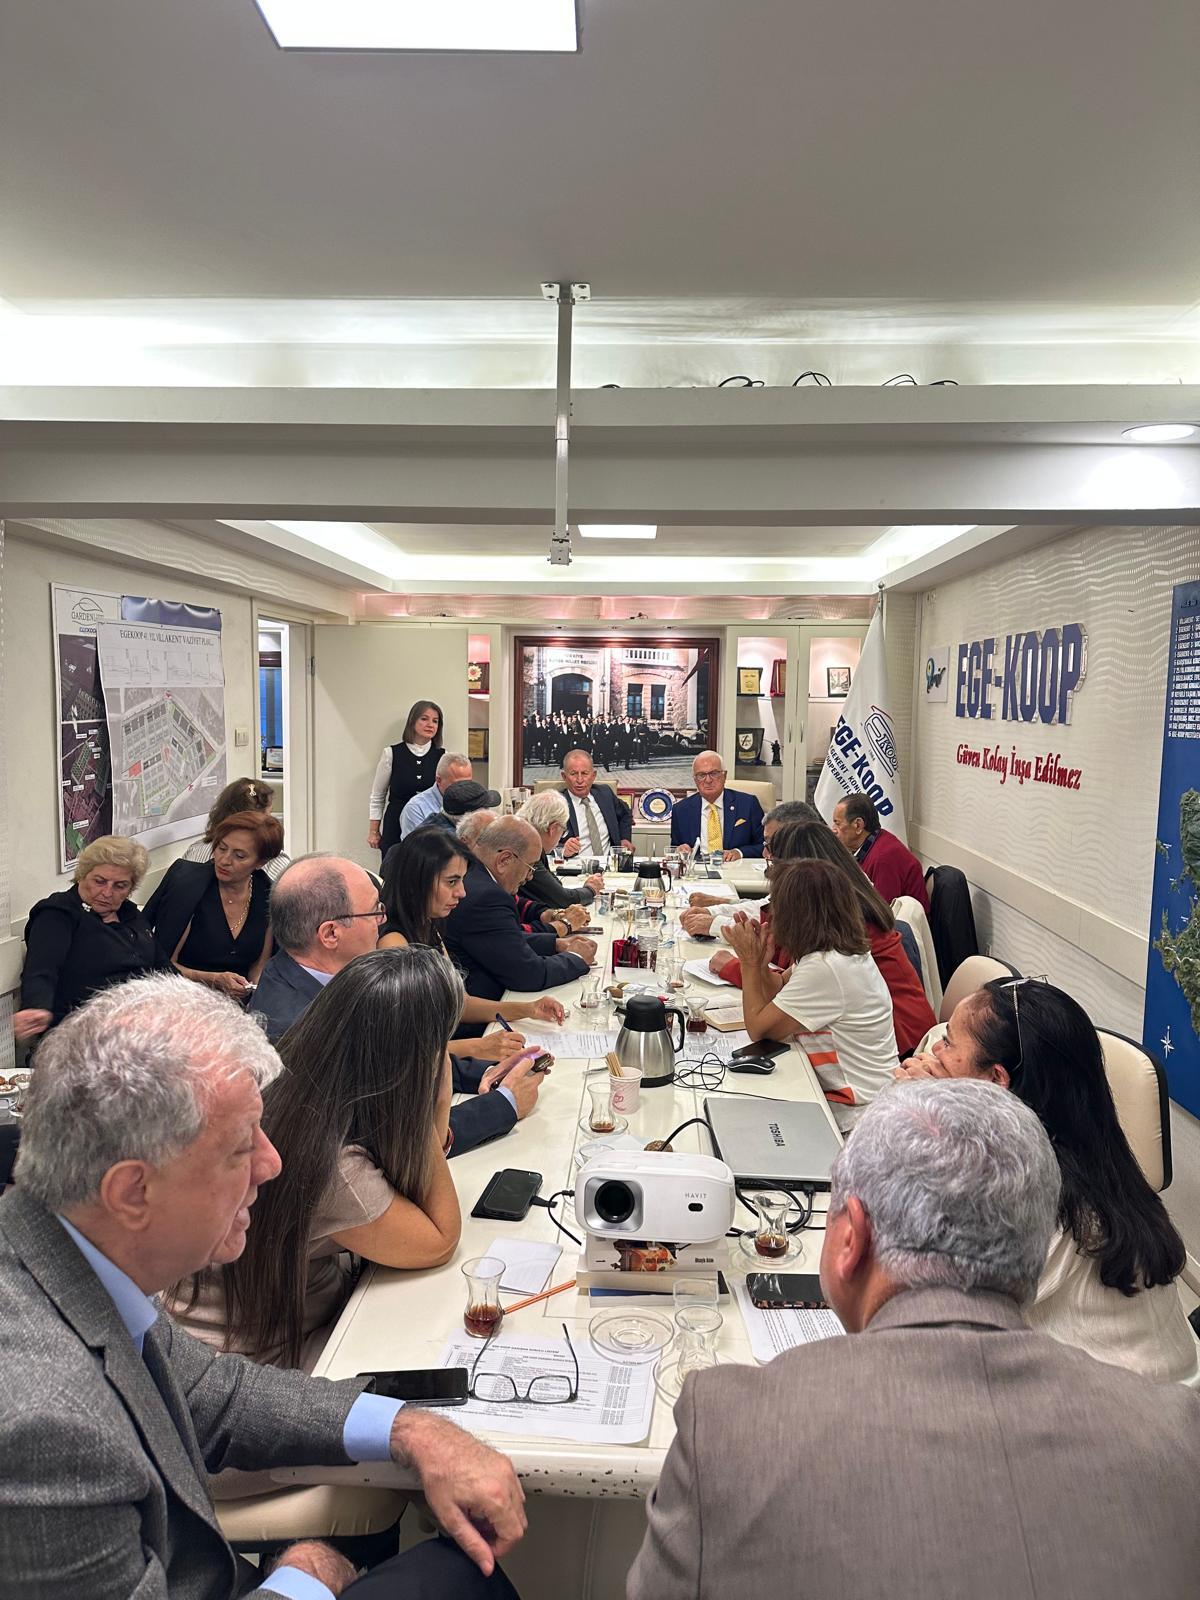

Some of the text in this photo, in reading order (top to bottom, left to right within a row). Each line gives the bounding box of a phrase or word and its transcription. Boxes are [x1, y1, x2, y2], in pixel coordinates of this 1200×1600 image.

[956, 623, 1087, 726] EGE-KOOP
[827, 755, 853, 796] OPERATİFL
[830, 745, 849, 774] GEKENT
[956, 743, 1082, 790] Güven Kolay İnşa Edilmez
[768, 1123, 785, 1147] TOSHIBA
